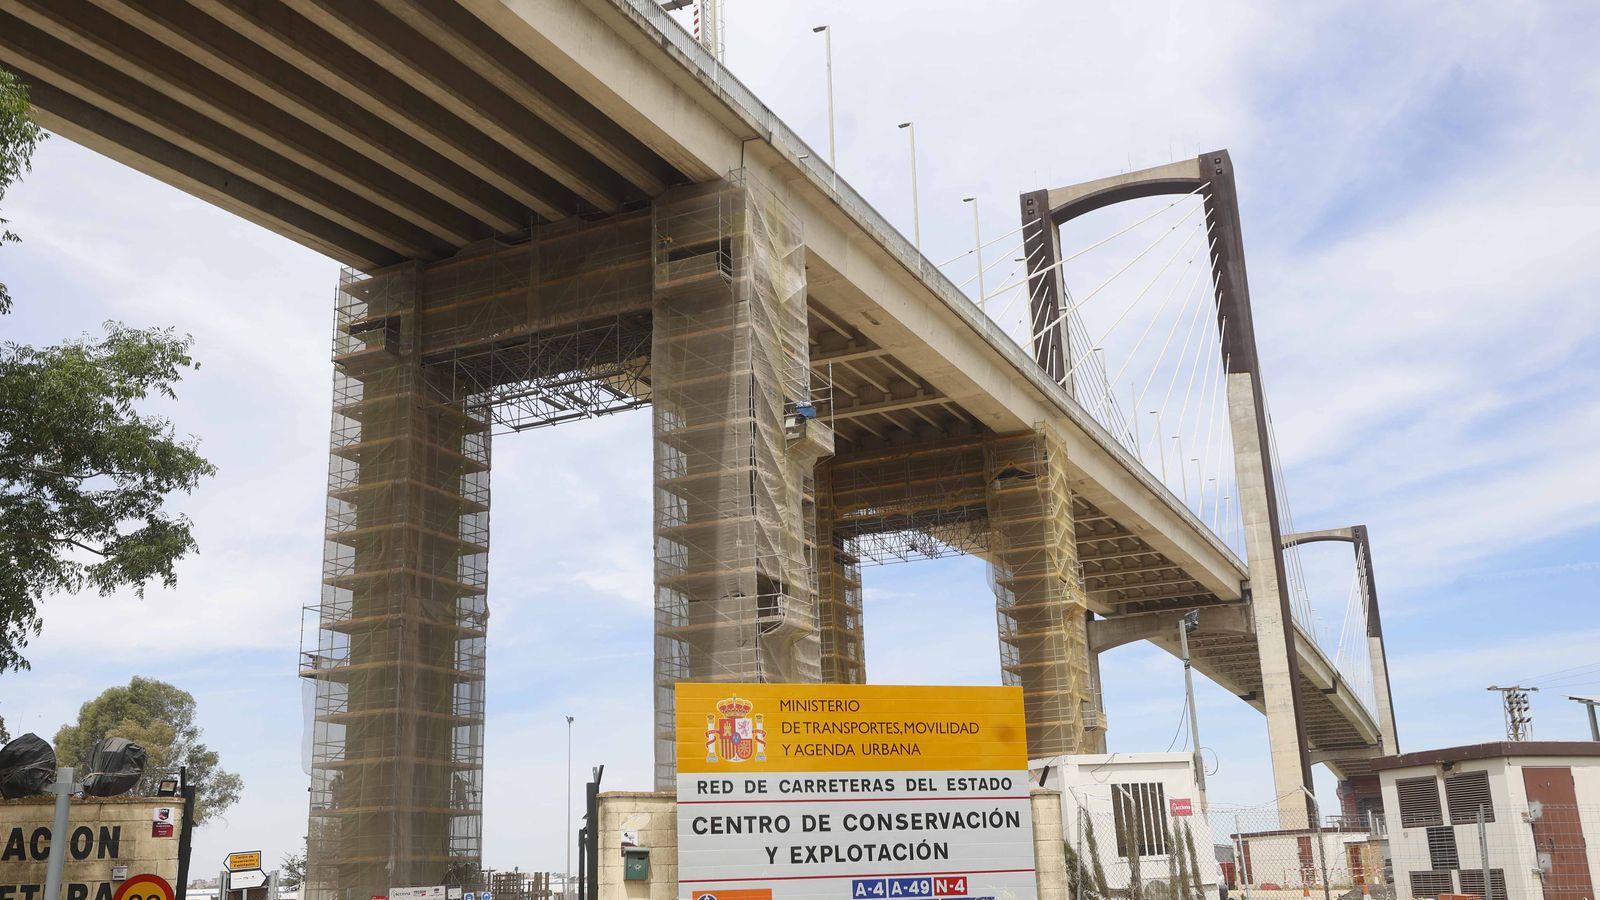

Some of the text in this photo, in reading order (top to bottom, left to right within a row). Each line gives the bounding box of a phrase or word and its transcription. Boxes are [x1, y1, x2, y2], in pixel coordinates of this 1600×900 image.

[780, 700, 860, 713] MINISTERIO
[781, 721, 801, 735] DE
[782, 743, 921, 757] Y AGENDA URBANA
[697, 777, 1013, 794] RED DE CARRETERAS DEL ESTADO
[692, 808, 1020, 835] CENTRO DE CONSERVACIÓN
[1, 825, 121, 861] ACON
[765, 840, 949, 865] Y EXPLOTACIÓN
[855, 879, 965, 897] A-4 A-49 N-4
